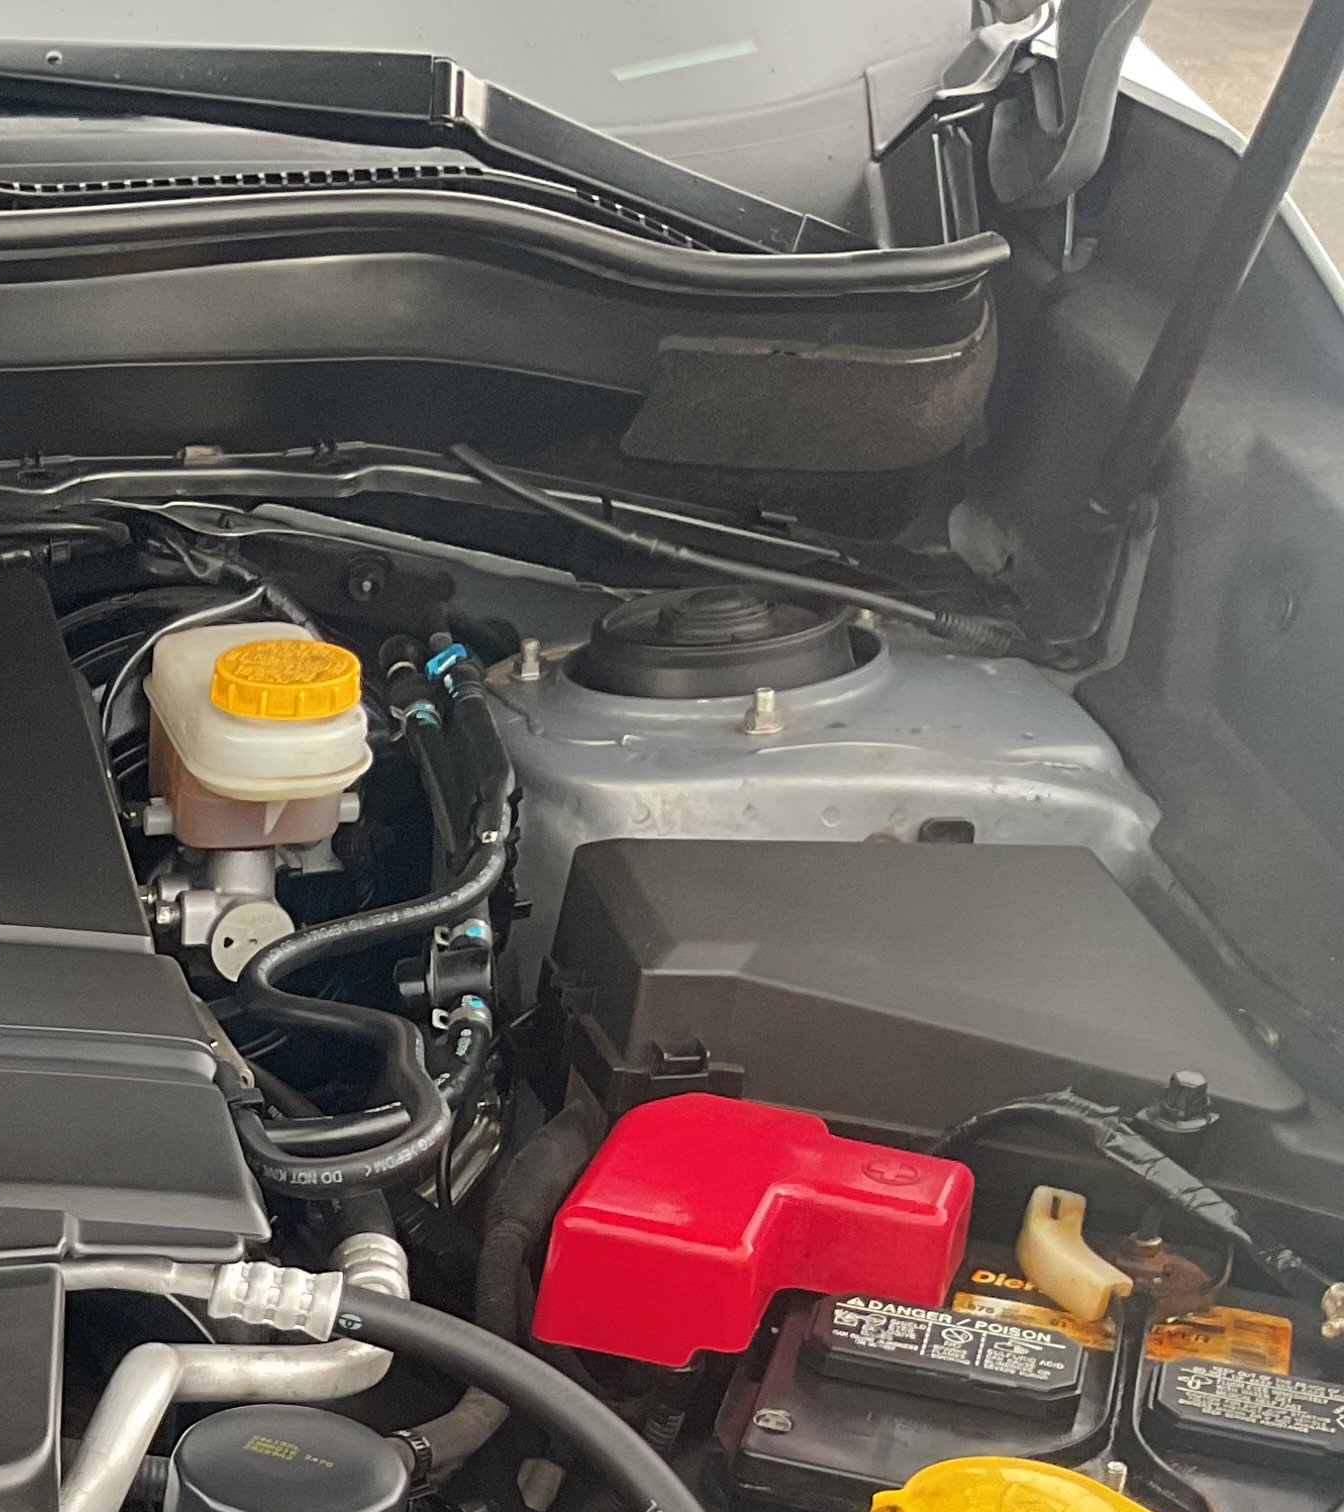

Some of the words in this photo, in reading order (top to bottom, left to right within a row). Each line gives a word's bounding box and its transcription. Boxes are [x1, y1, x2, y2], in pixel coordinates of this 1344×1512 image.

[320, 1170, 343, 1185] DO
[868, 1299, 952, 1324] DANGER
[974, 1320, 1052, 1343] POISON
